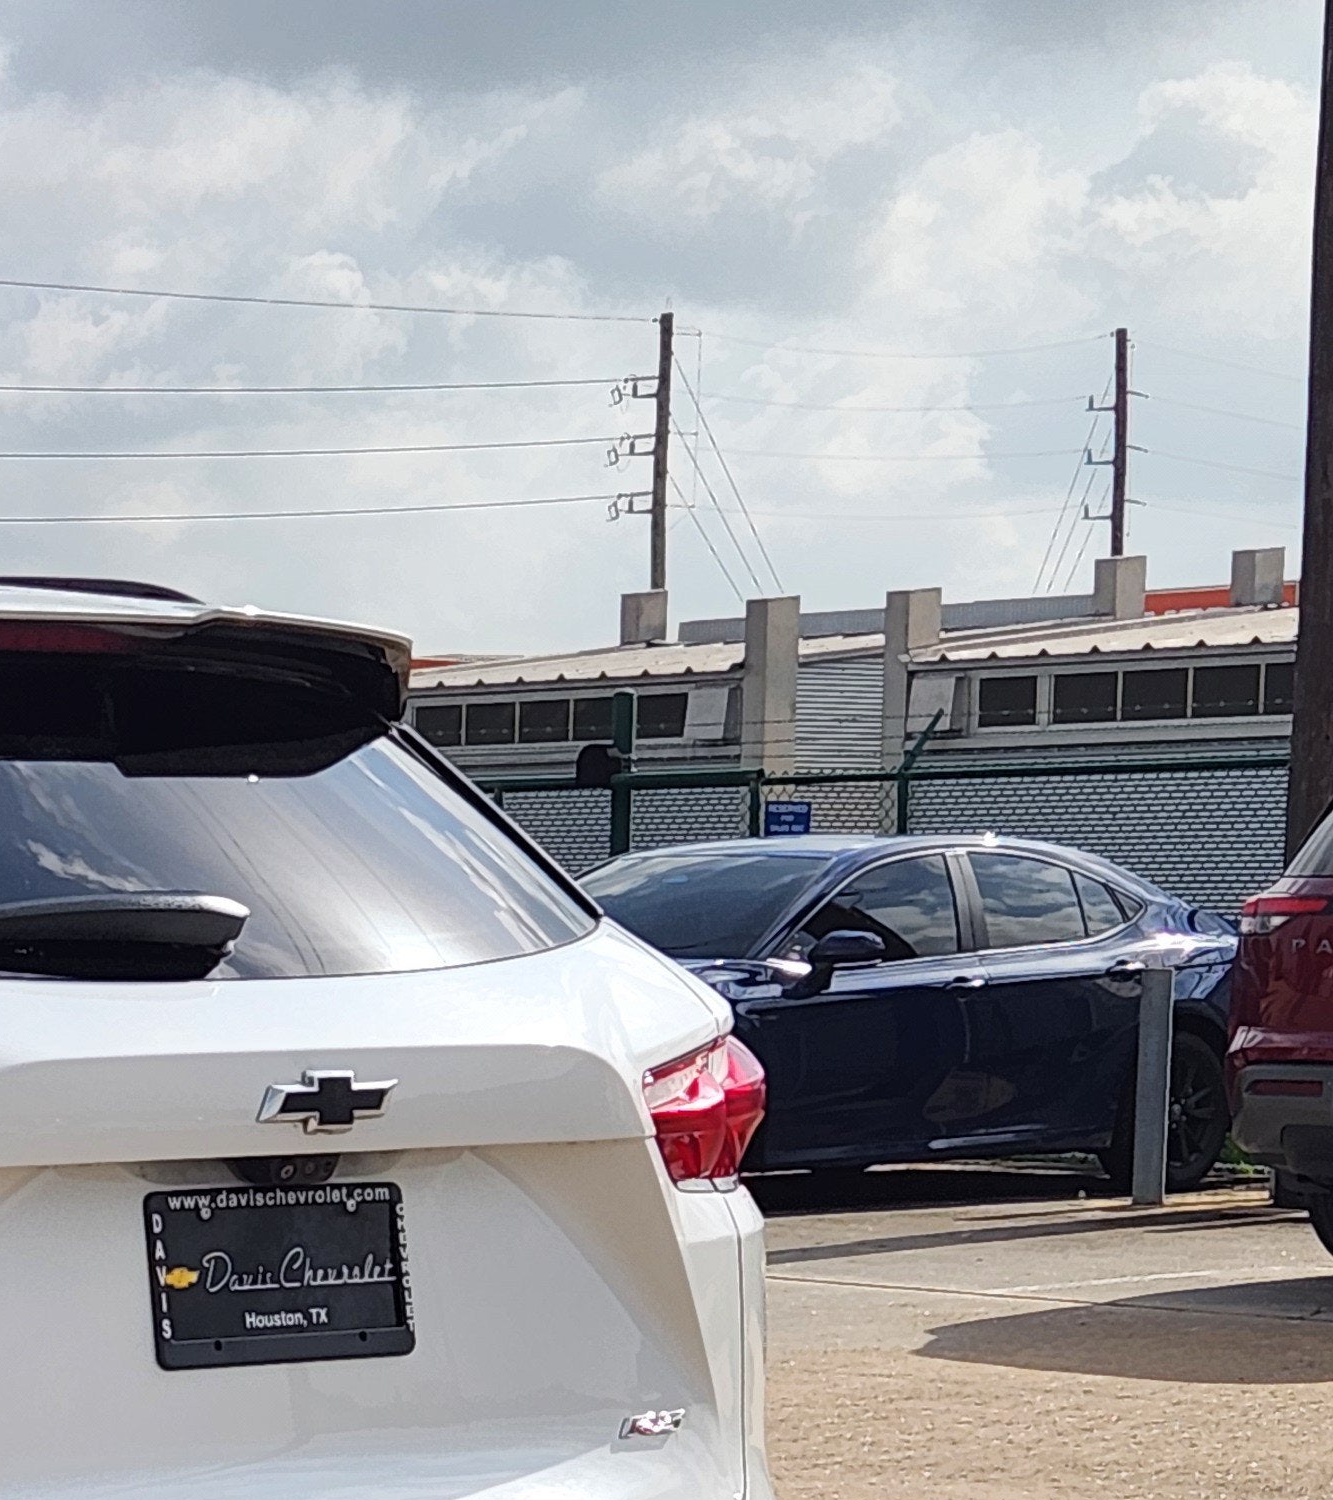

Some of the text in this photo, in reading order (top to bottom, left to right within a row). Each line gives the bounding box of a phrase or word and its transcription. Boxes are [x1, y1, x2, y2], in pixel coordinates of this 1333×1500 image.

[167, 1186, 390, 1211] www.davischevrolet.com
[150, 1212, 173, 1340] DAVIS
[201, 1246, 397, 1292] Davis Chevrolet
[244, 1307, 329, 1330] Houston, TX
